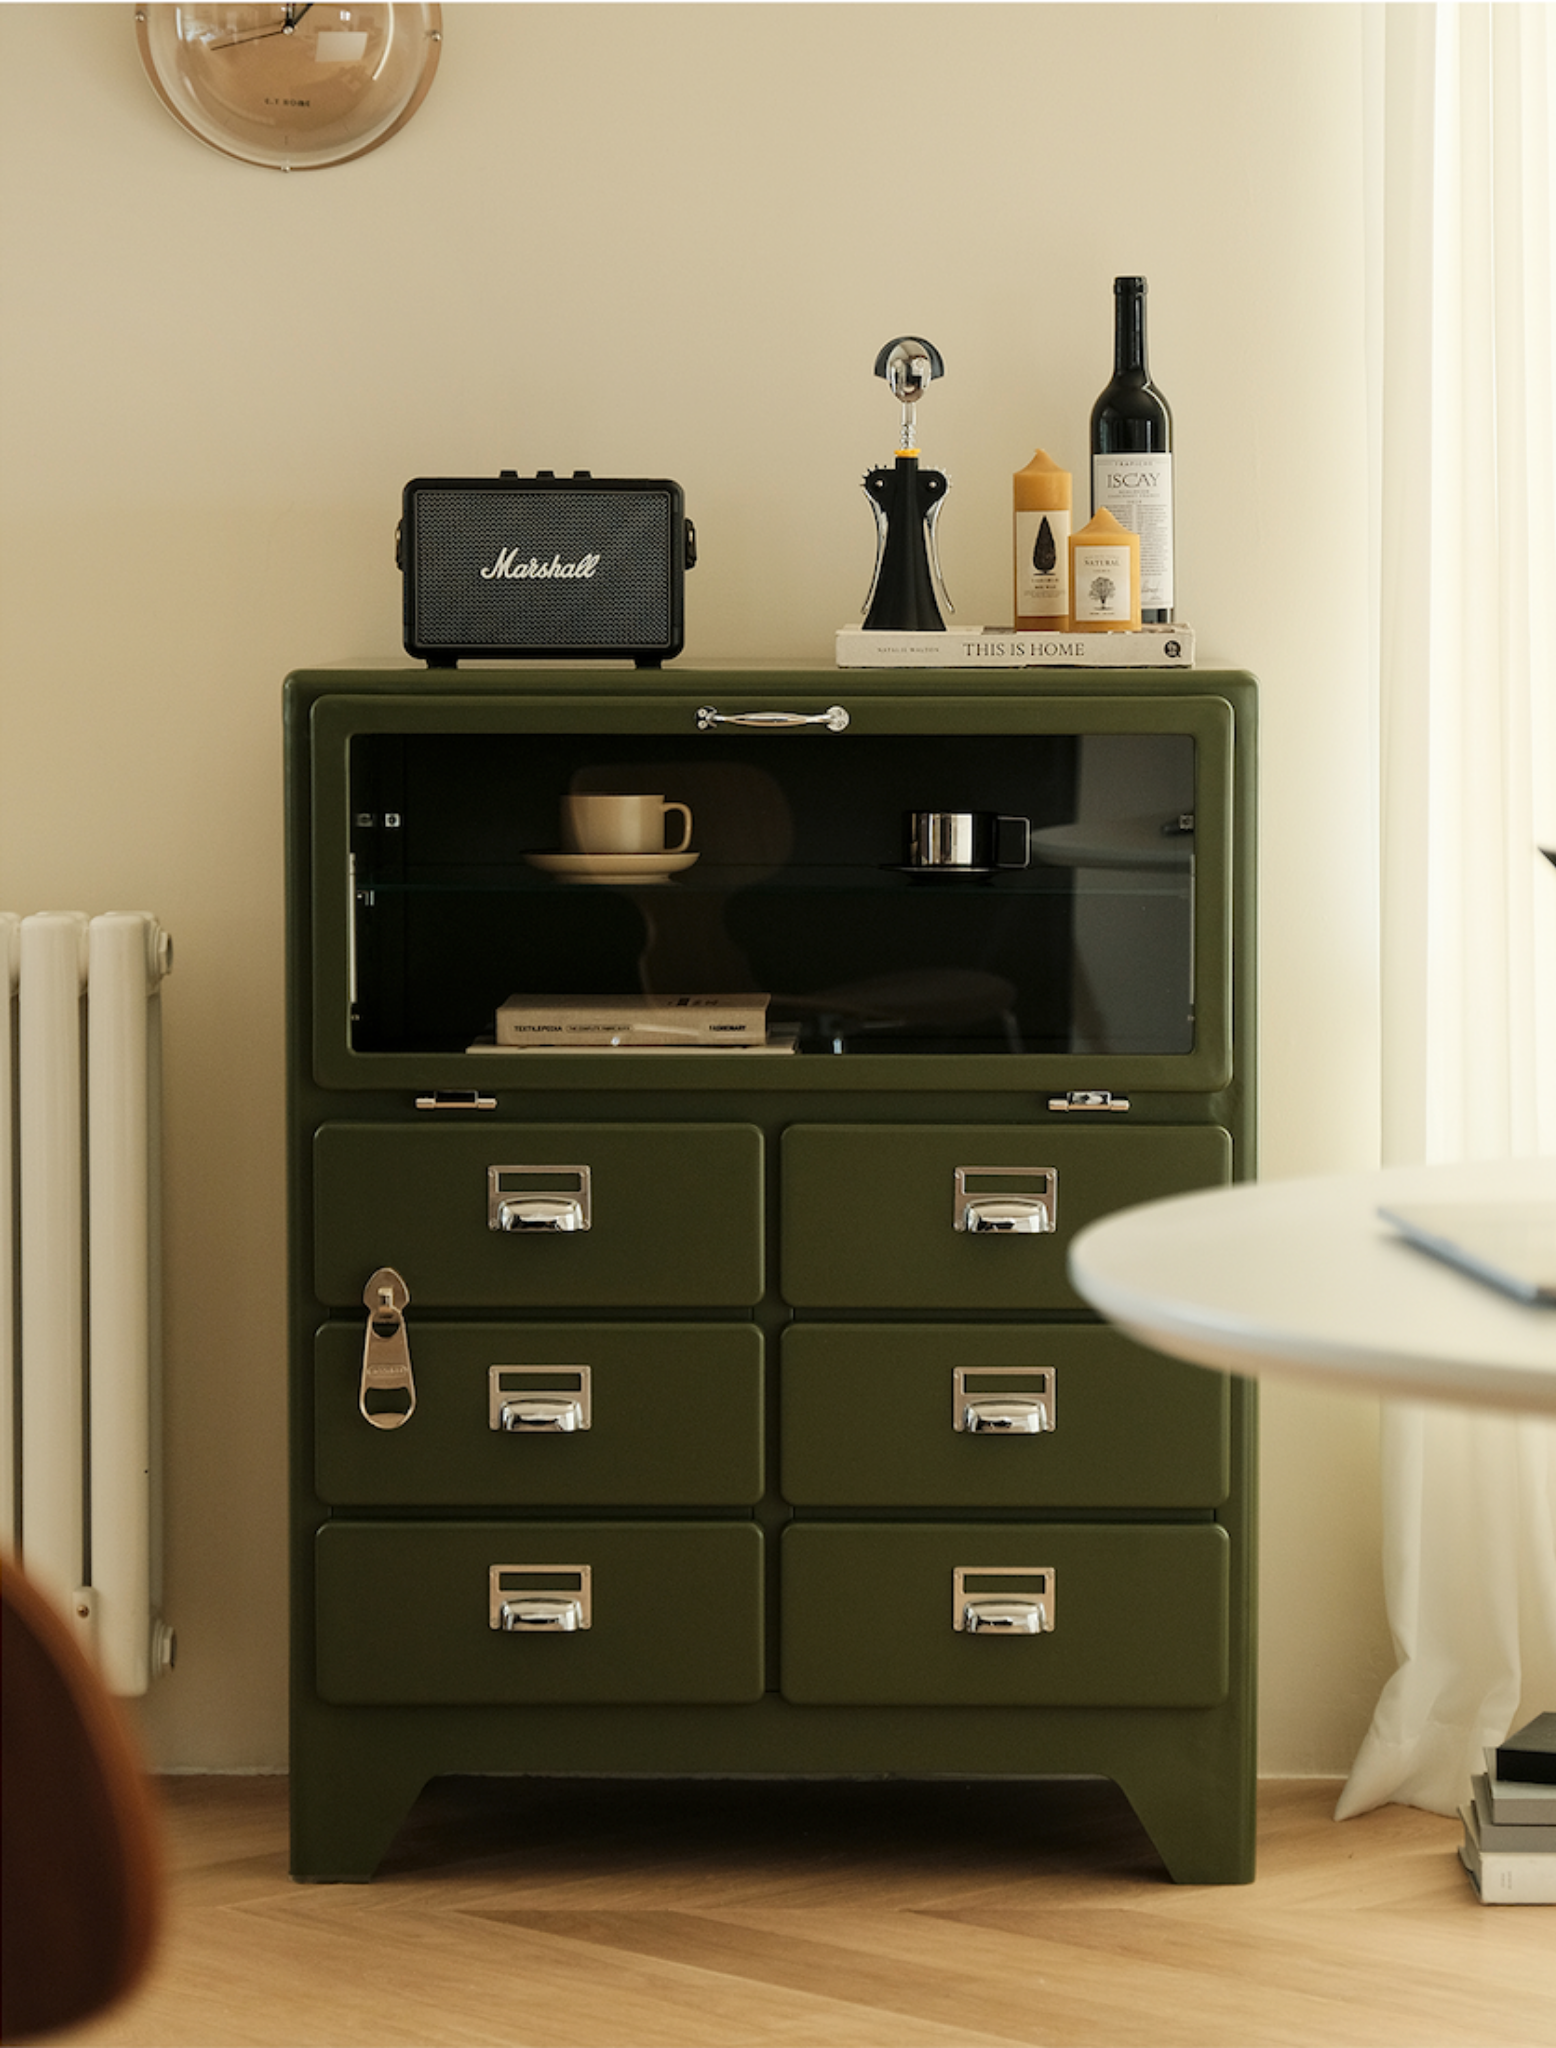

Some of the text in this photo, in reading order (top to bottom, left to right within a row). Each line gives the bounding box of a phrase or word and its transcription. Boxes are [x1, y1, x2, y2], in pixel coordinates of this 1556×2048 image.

[1107, 472, 1160, 489] ISCAY
[480, 547, 600, 579] Marshall
[963, 643, 1085, 657] THIS IS HOME
